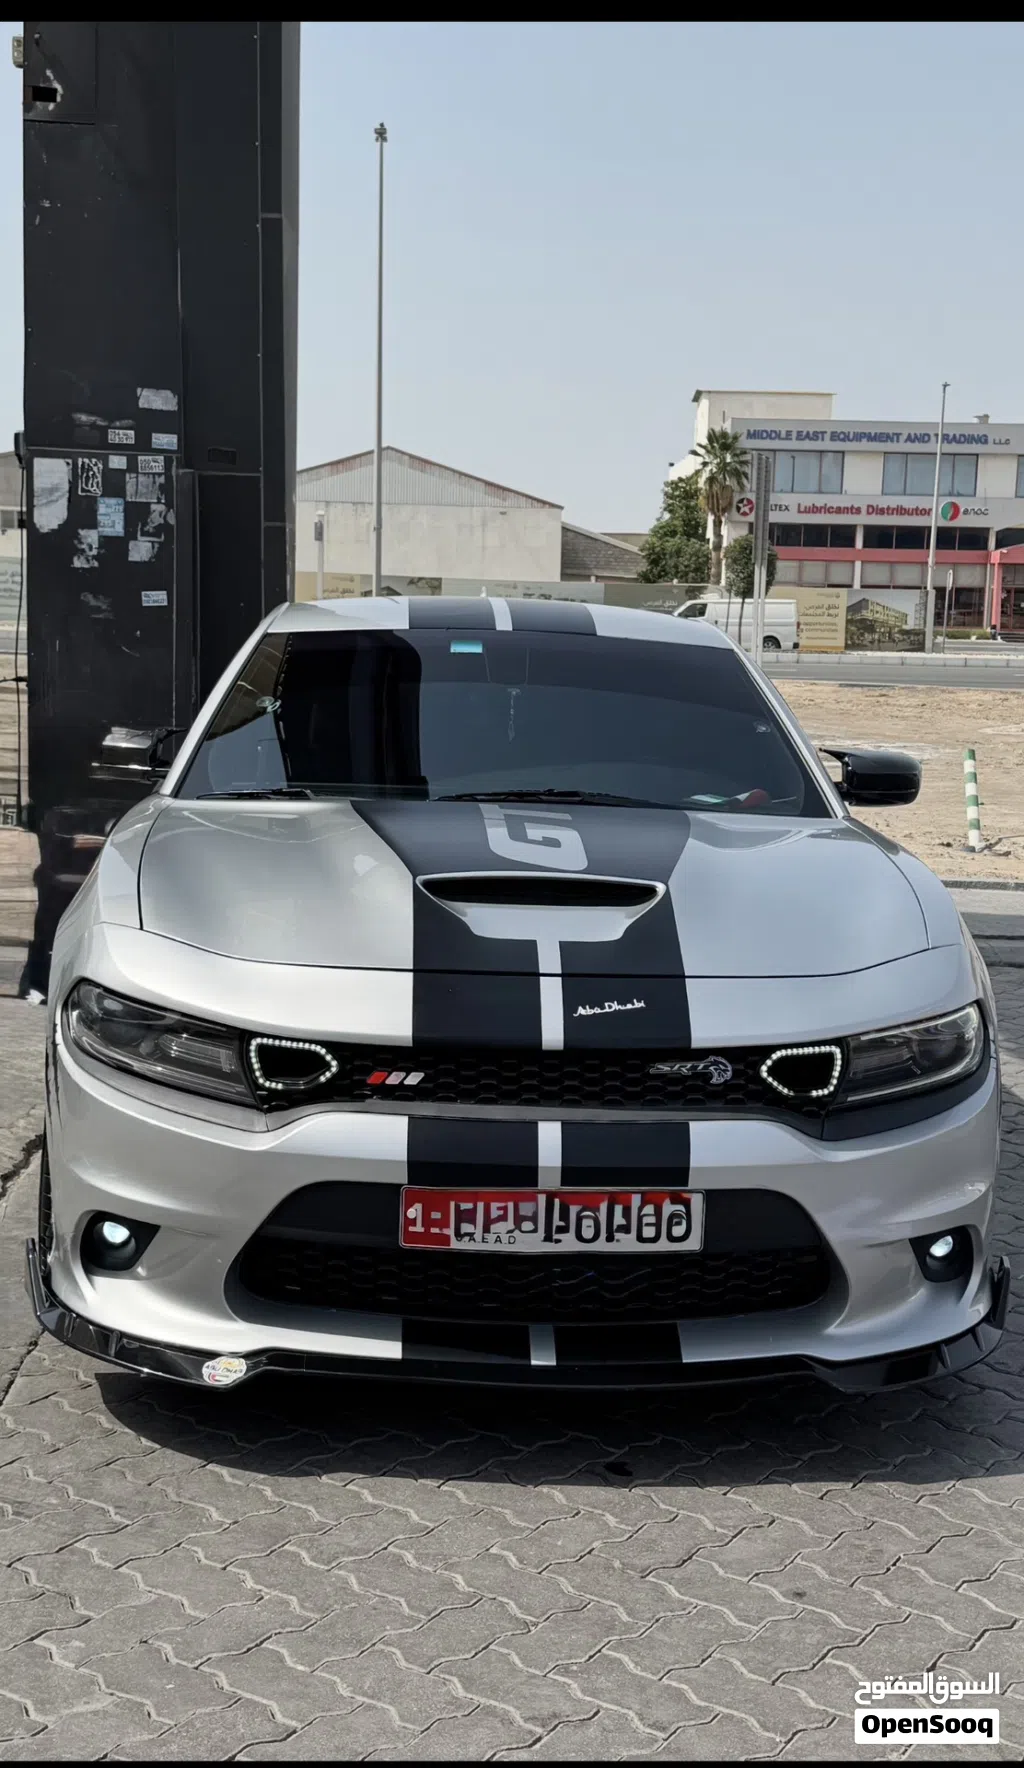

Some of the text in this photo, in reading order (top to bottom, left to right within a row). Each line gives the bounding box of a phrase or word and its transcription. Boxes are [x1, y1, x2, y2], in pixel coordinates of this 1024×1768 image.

[746, 429, 793, 441] MIDDLE
[796, 430, 828, 442] EAST
[829, 431, 902, 443] EQUIPMENT
[904, 432, 931, 444] AND
[797, 503, 862, 515] Lubricants
[866, 504, 933, 516] Distributor
[962, 508, 989, 516] enoc
